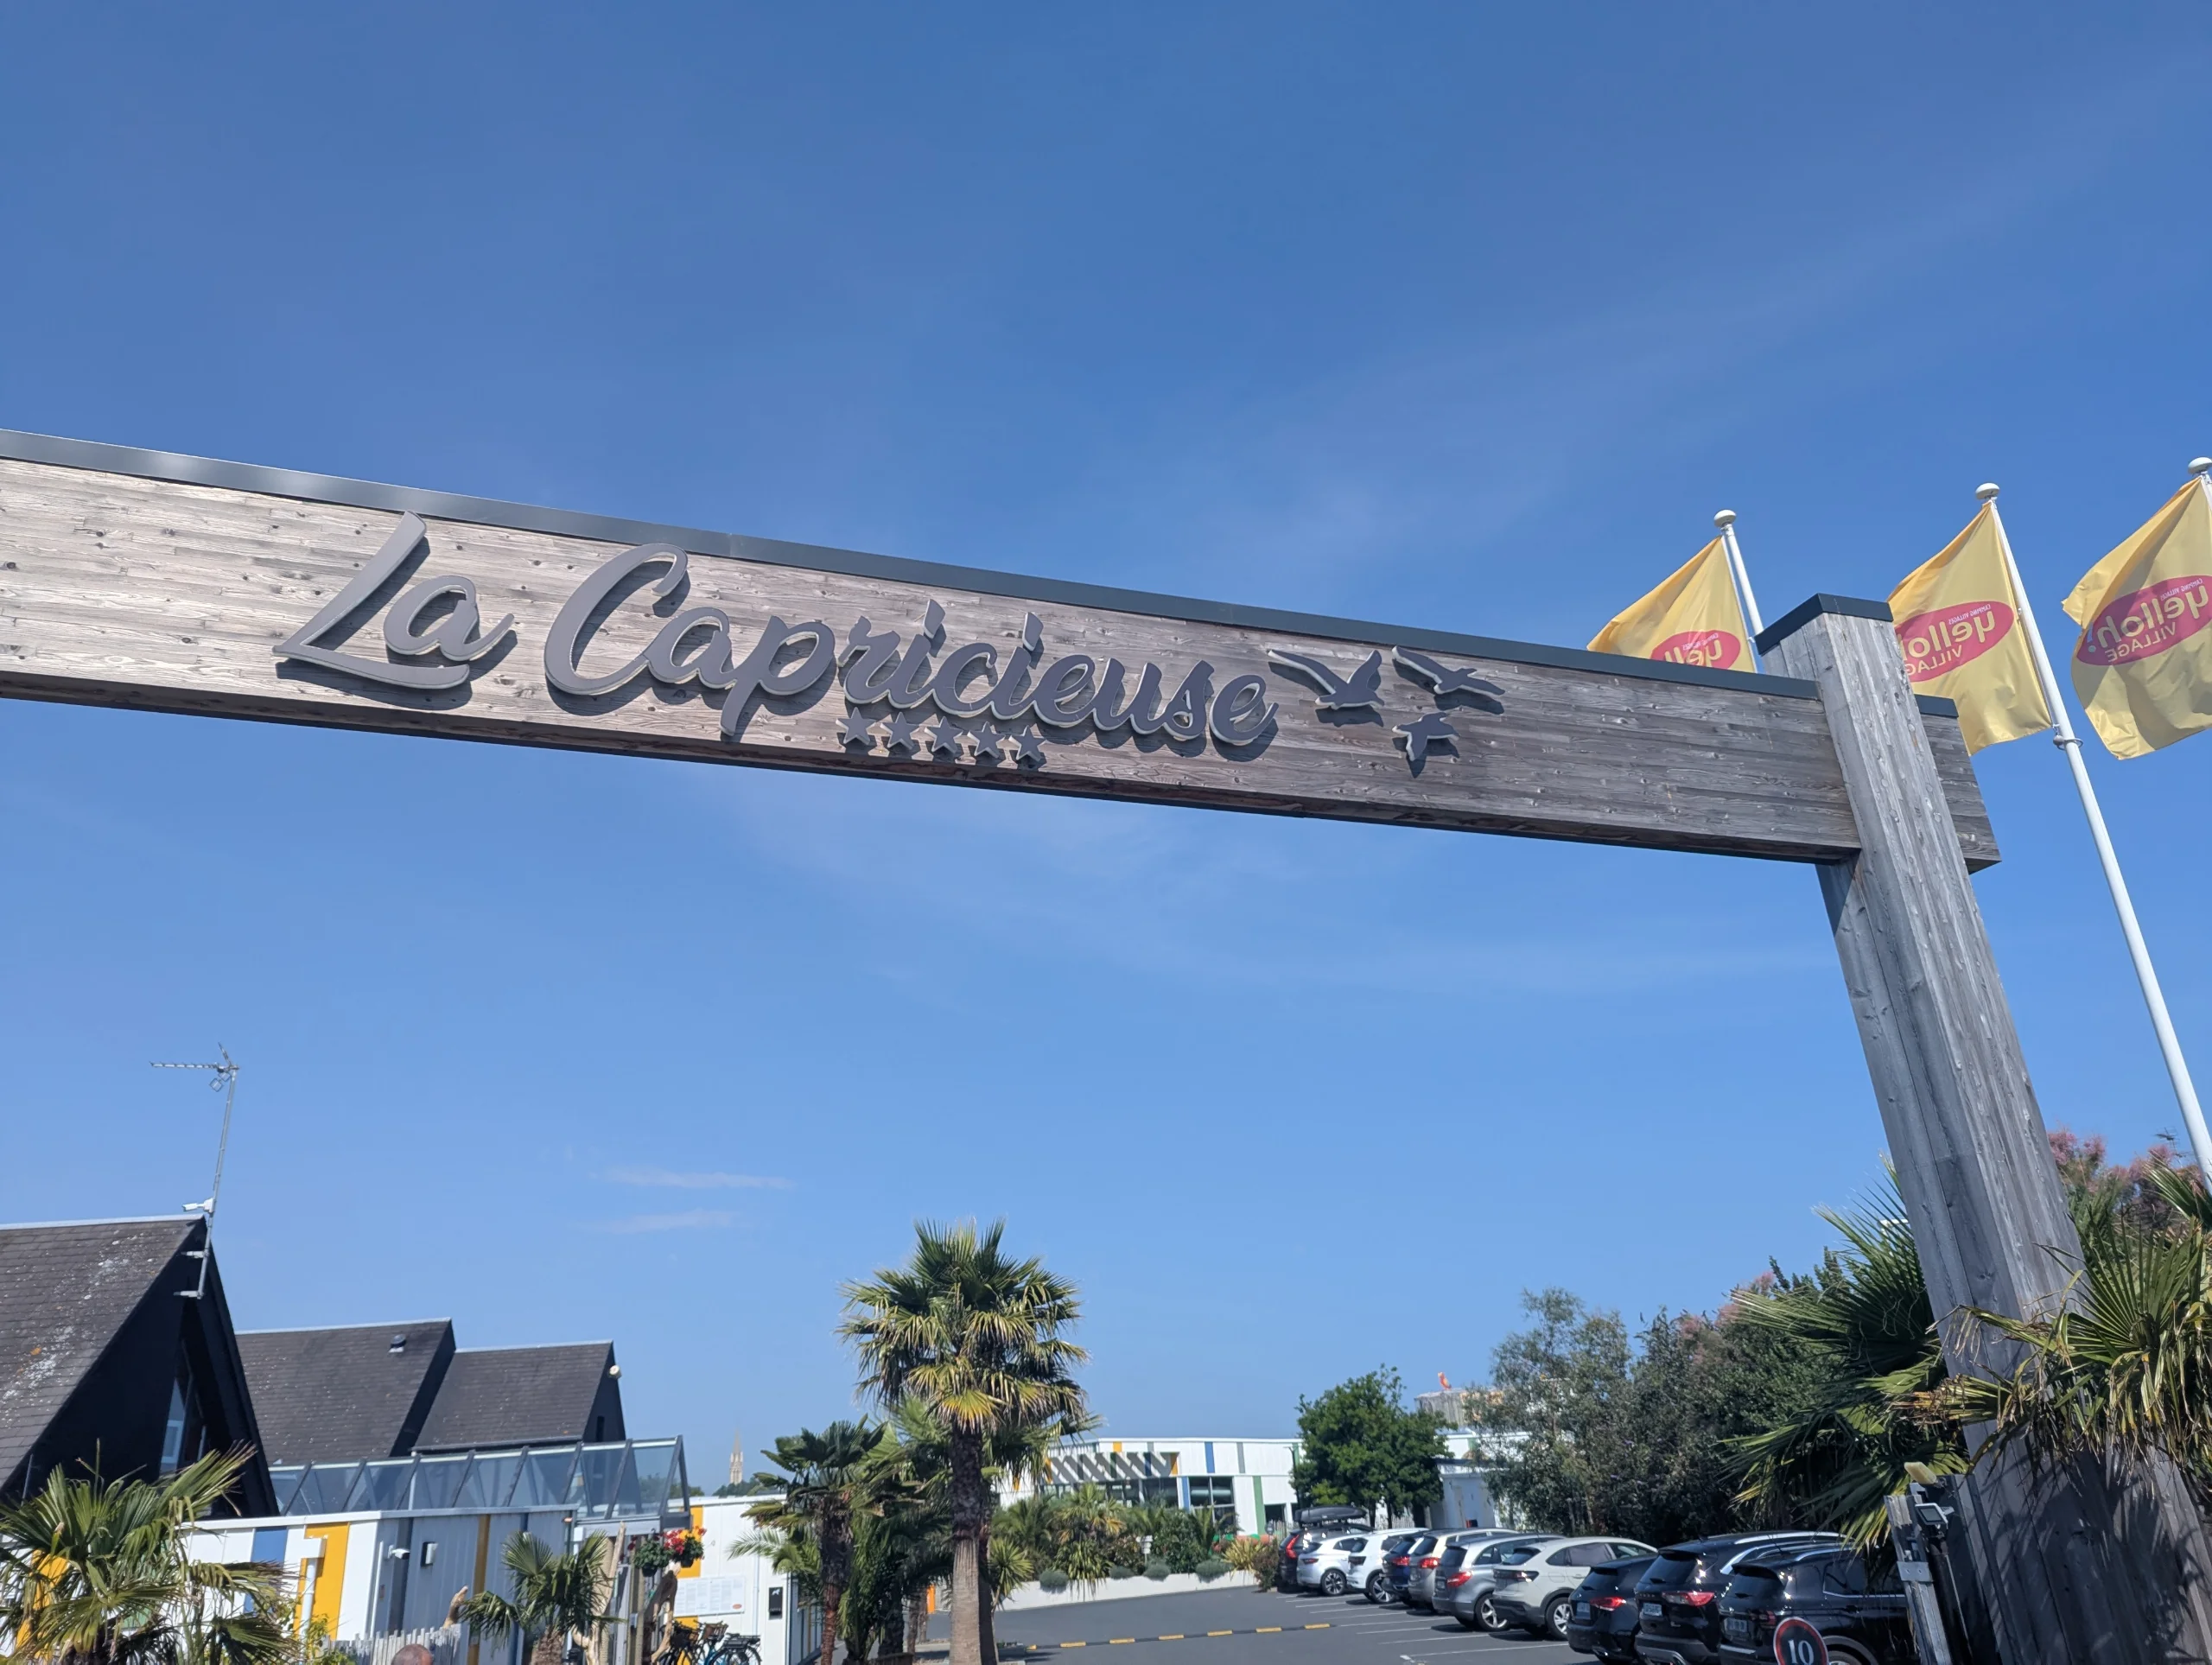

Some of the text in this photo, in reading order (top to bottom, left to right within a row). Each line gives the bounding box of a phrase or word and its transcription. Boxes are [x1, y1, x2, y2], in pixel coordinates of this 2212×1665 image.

[272, 510, 1279, 745] La Capricieuse
[1788, 1639, 1815, 1665] 10
